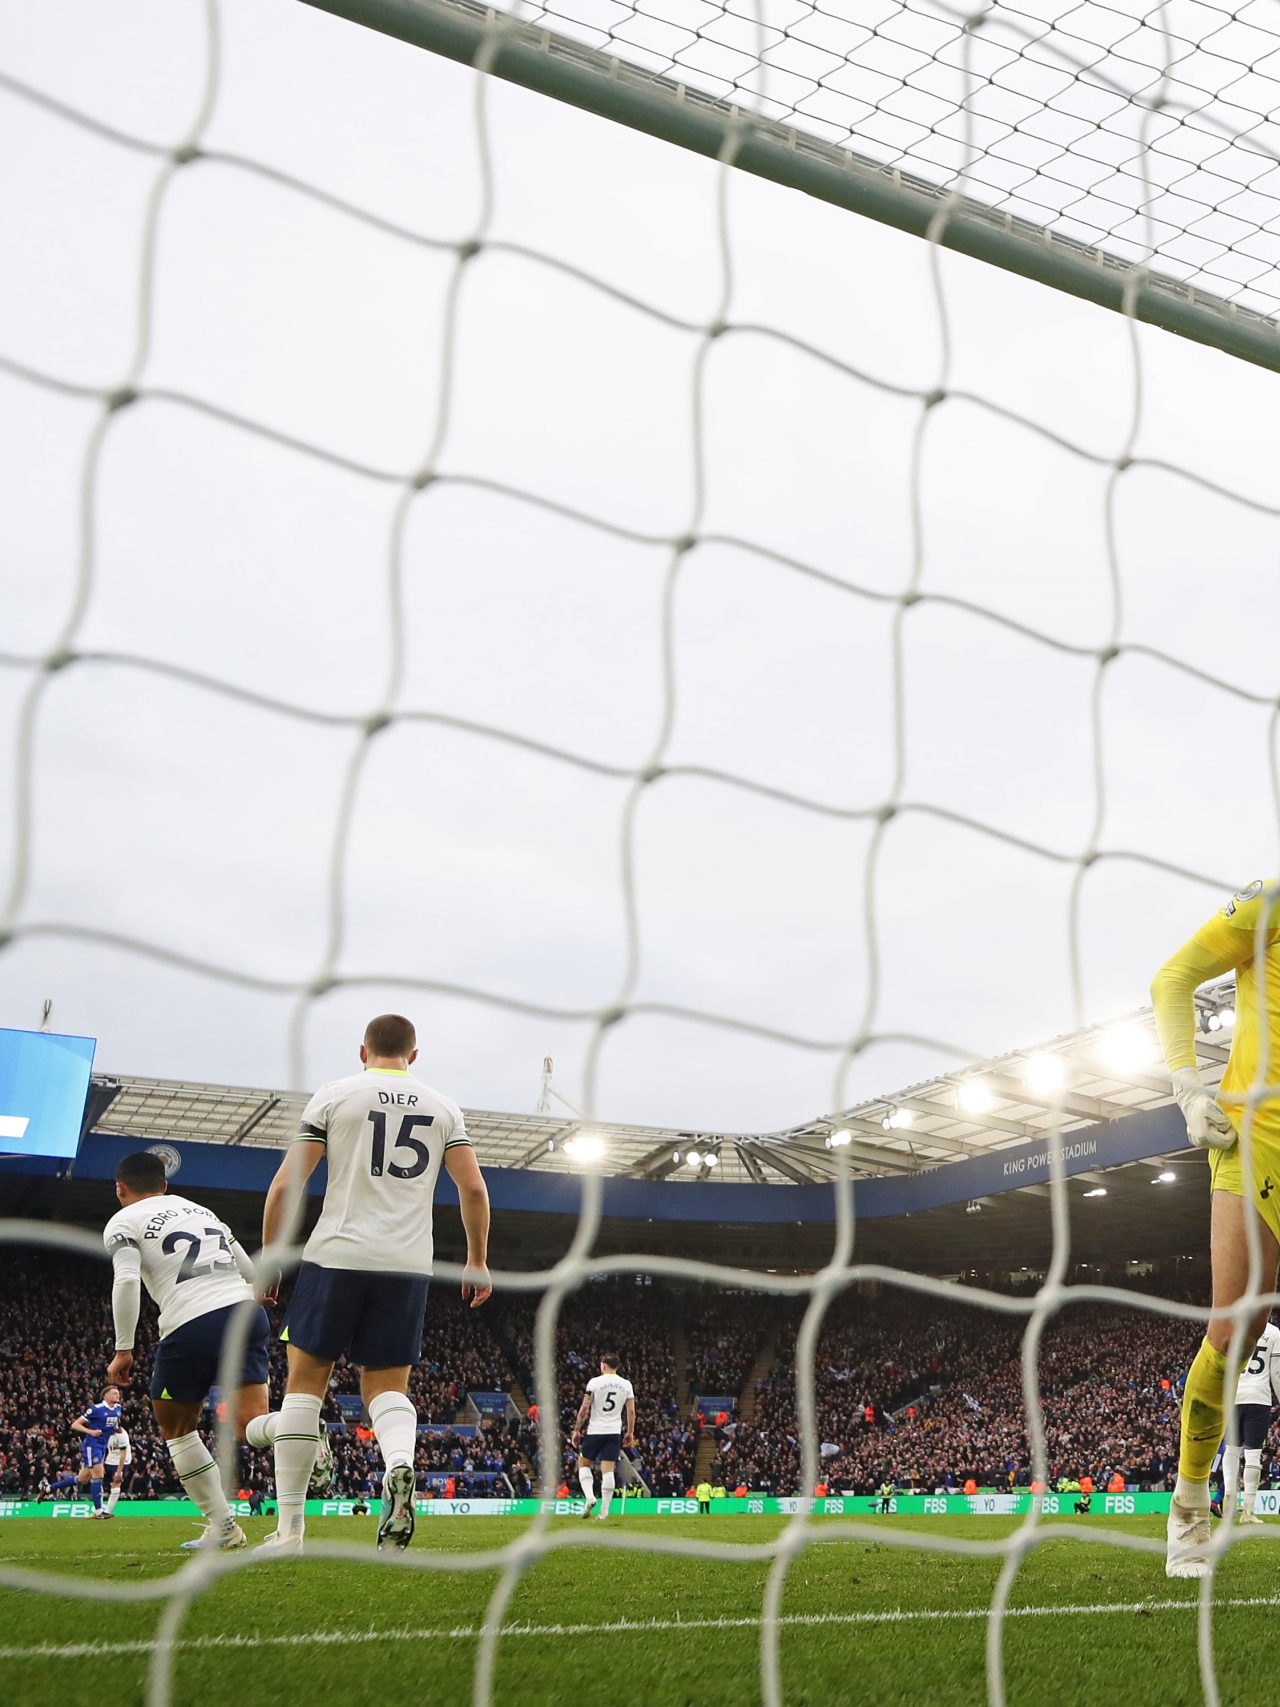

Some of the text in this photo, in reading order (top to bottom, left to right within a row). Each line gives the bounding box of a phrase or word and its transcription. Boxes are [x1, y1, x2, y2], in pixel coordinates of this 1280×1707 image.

[378, 1091, 419, 1107] DIER
[367, 1110, 435, 1179] 15
[1003, 1159, 1026, 1177] KING
[1060, 1140, 1097, 1161] STADIUM
[144, 1208, 179, 1240] PEDRO
[161, 1227, 237, 1285] 23
[602, 1391, 617, 1412] 5
[450, 1502, 470, 1514] YO
[656, 1500, 699, 1514] FBS
[748, 1500, 764, 1513] FBS
[789, 1501, 798, 1512] YO
[824, 1499, 844, 1514] FBS
[924, 1498, 947, 1513] FBS
[984, 1499, 995, 1512] YO
[1104, 1495, 1135, 1514] FBS
[1261, 1495, 1277, 1511] YO
